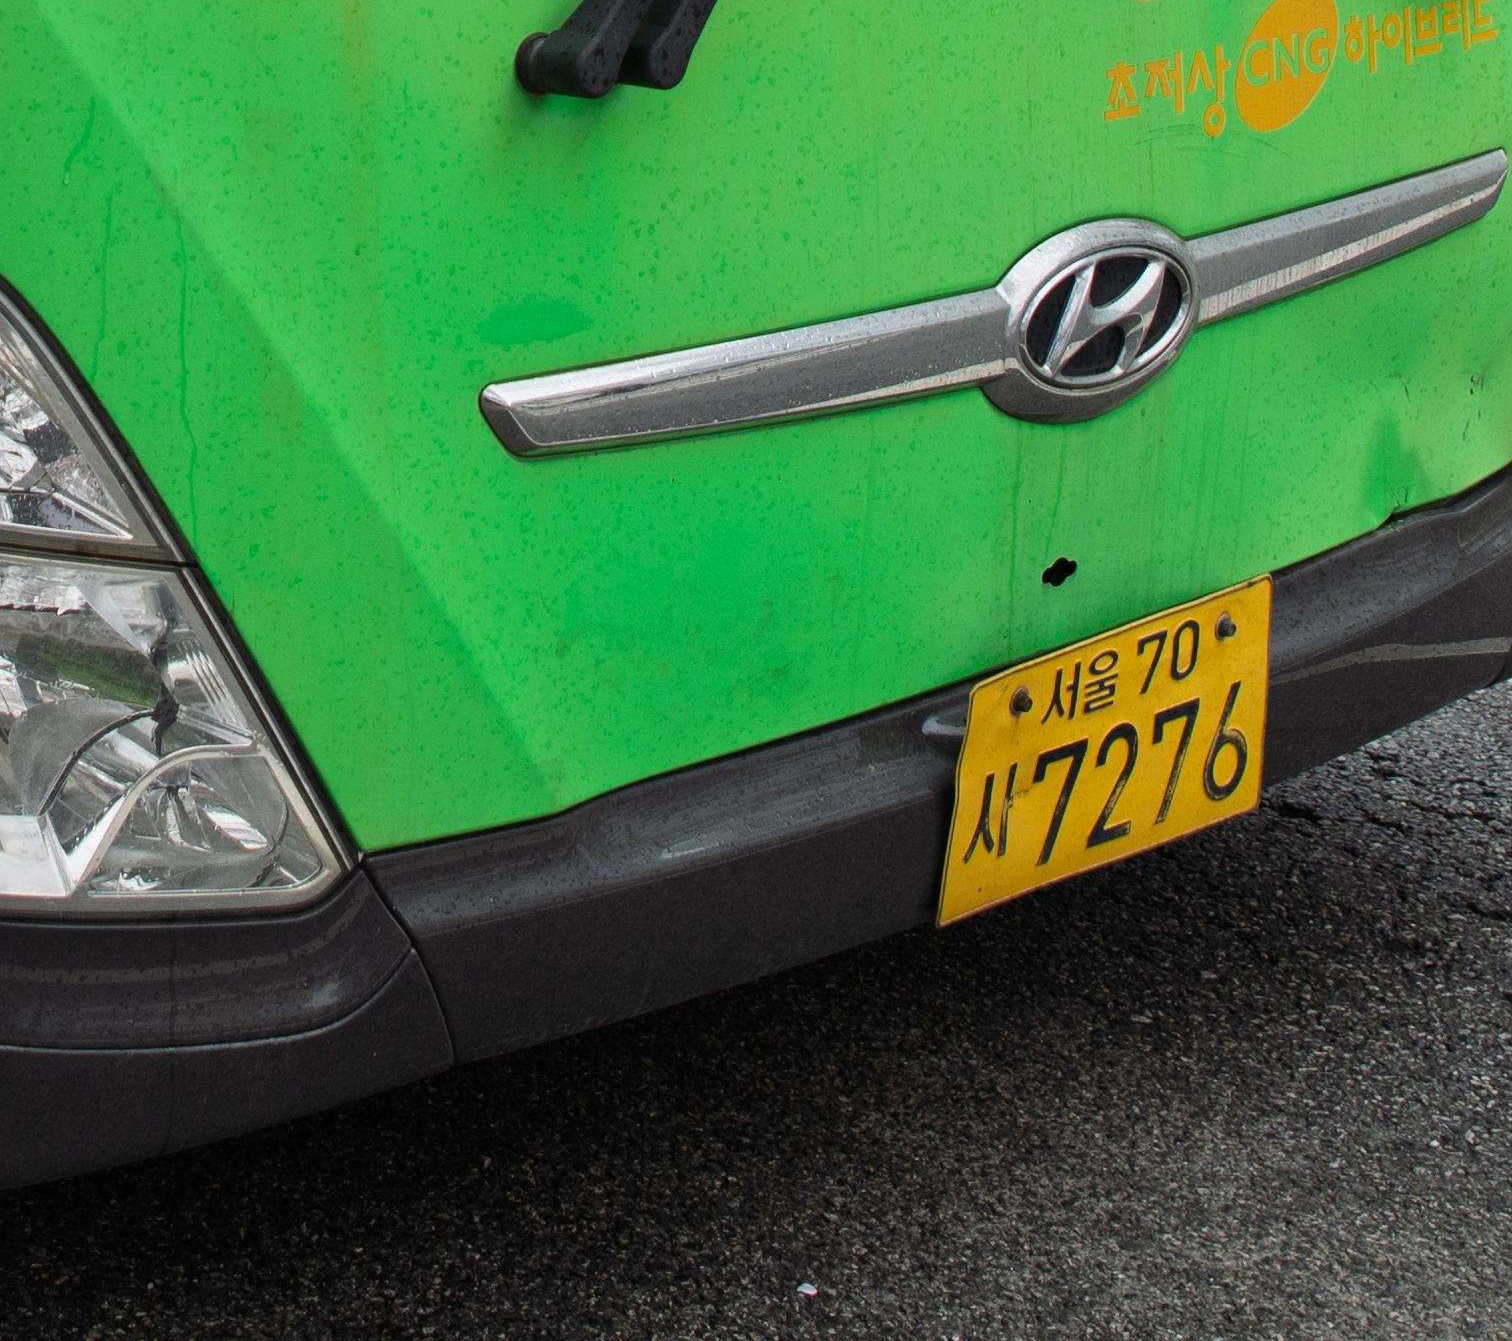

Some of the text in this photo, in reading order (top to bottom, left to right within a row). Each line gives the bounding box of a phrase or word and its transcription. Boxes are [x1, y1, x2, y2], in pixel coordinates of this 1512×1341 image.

[1103, 44, 1231, 138] 초저상
[1243, 27, 1331, 87] CNG
[1041, 618, 1201, 724] 서울 70
[1032, 679, 1249, 867] 7276
